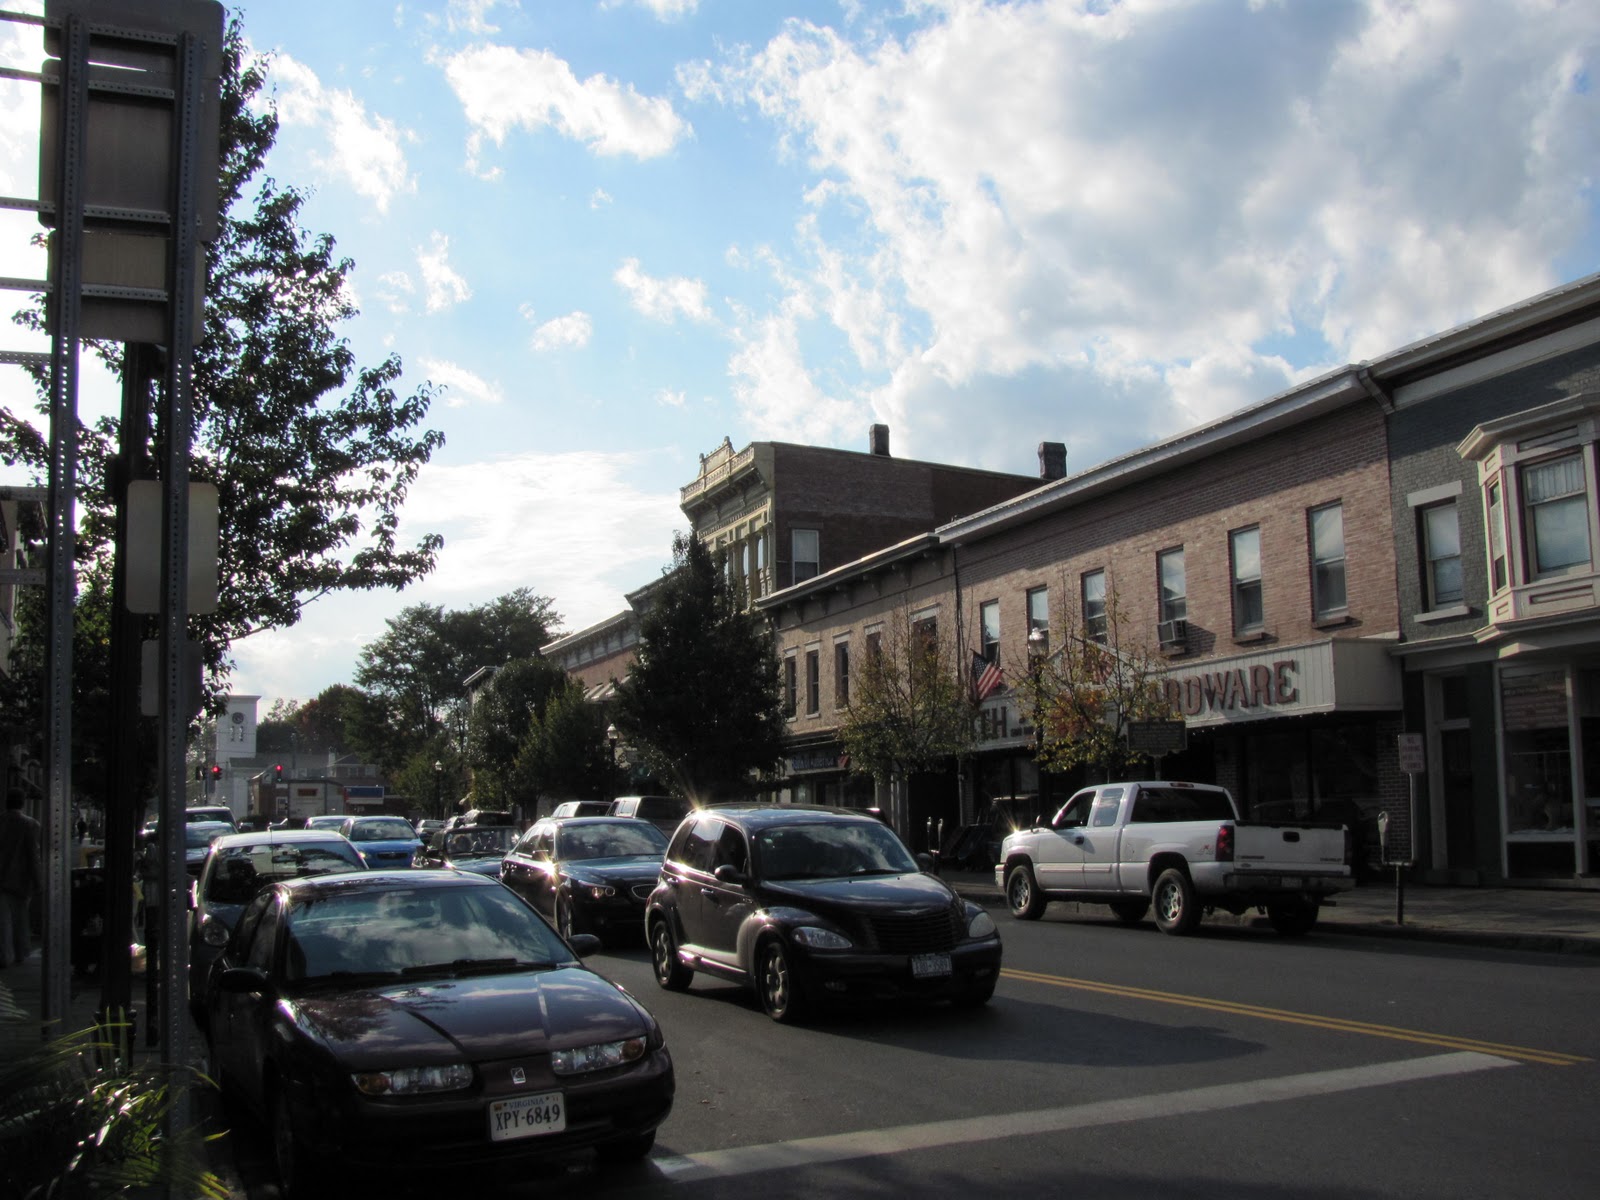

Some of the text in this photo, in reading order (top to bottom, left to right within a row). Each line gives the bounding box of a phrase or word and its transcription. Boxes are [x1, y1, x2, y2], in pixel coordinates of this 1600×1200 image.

[1124, 659, 1298, 716] ARDWARE
[509, 1098, 544, 1109] VIRGINIA
[496, 1104, 560, 1131] XPY-6849
